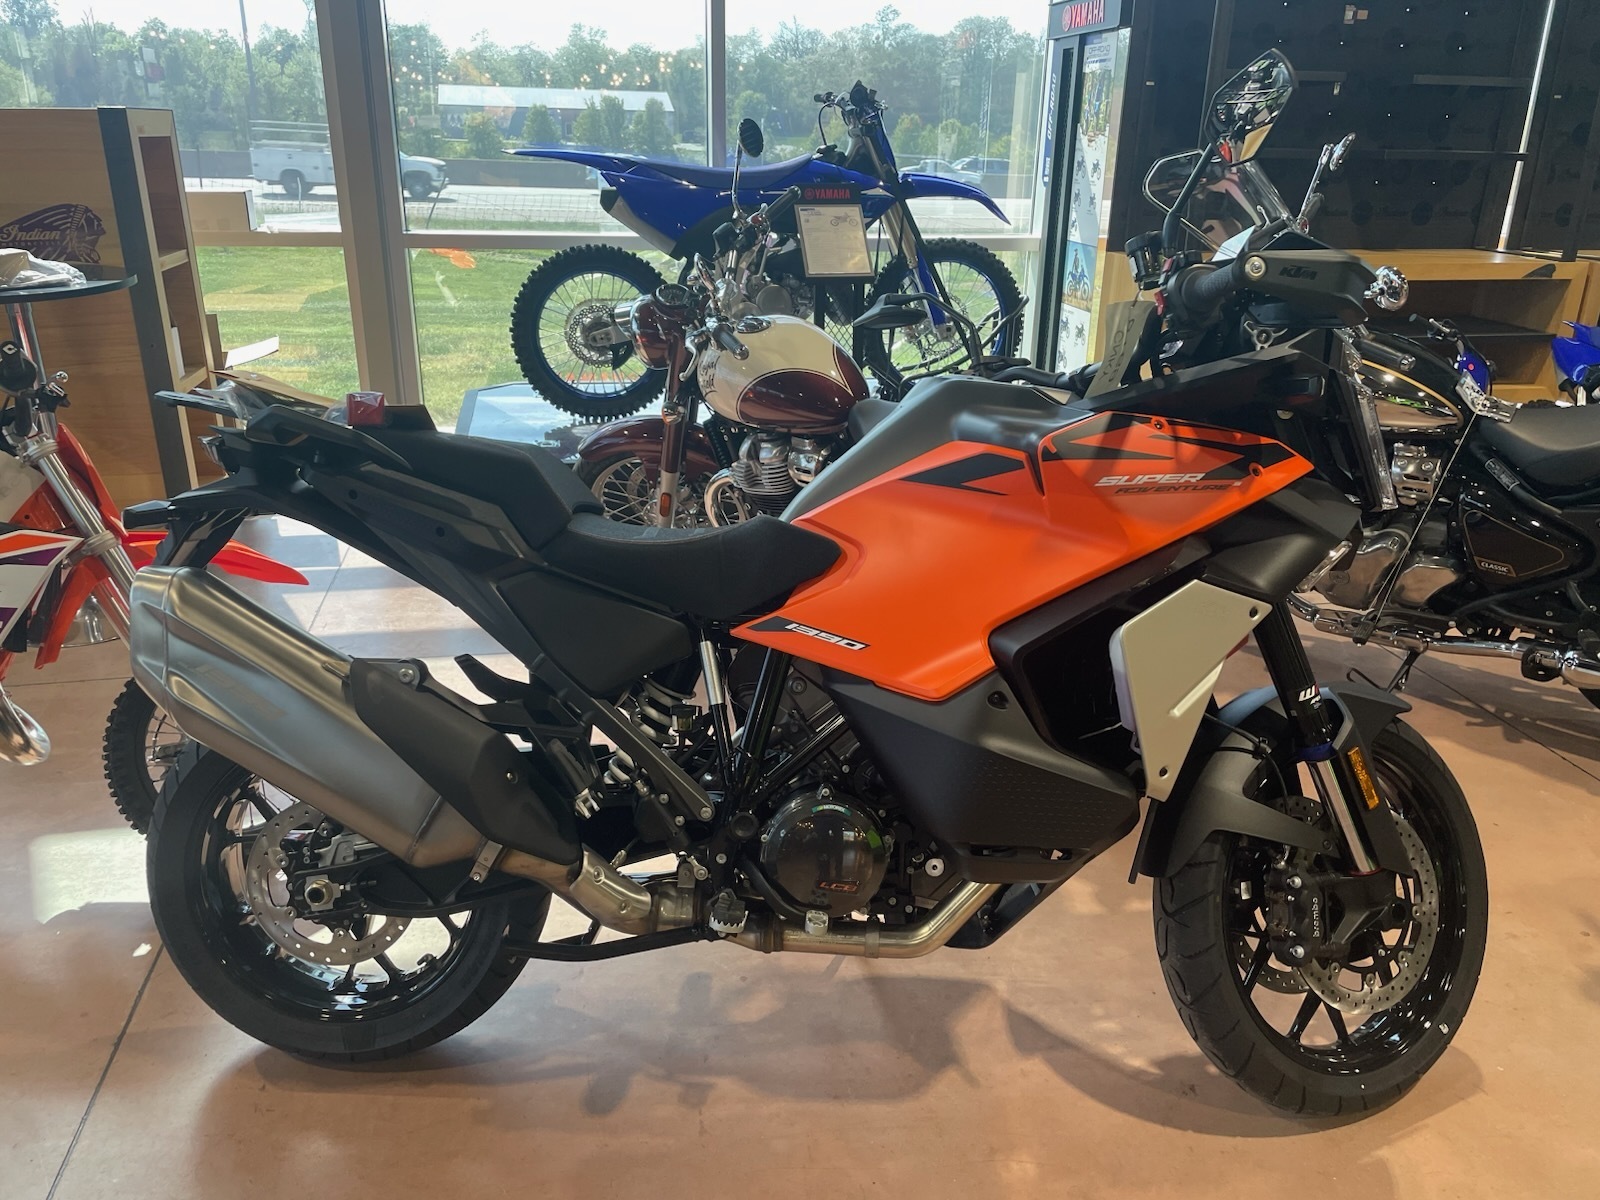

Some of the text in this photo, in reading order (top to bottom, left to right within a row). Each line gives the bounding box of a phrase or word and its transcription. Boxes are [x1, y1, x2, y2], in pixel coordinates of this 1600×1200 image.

[1071, 0, 1104, 28] YAMAHA
[1046, 72, 1057, 140] OFF-ROAD
[815, 188, 850, 199] YAMAHA
[0, 224, 60, 241] Indian
[1279, 264, 1318, 280] KTM
[1094, 473, 1206, 487] SUPER
[1114, 484, 1232, 495] ADVENTURE
[1481, 561, 1509, 573] CLASSIC
[1312, 897, 1320, 938] brembo
